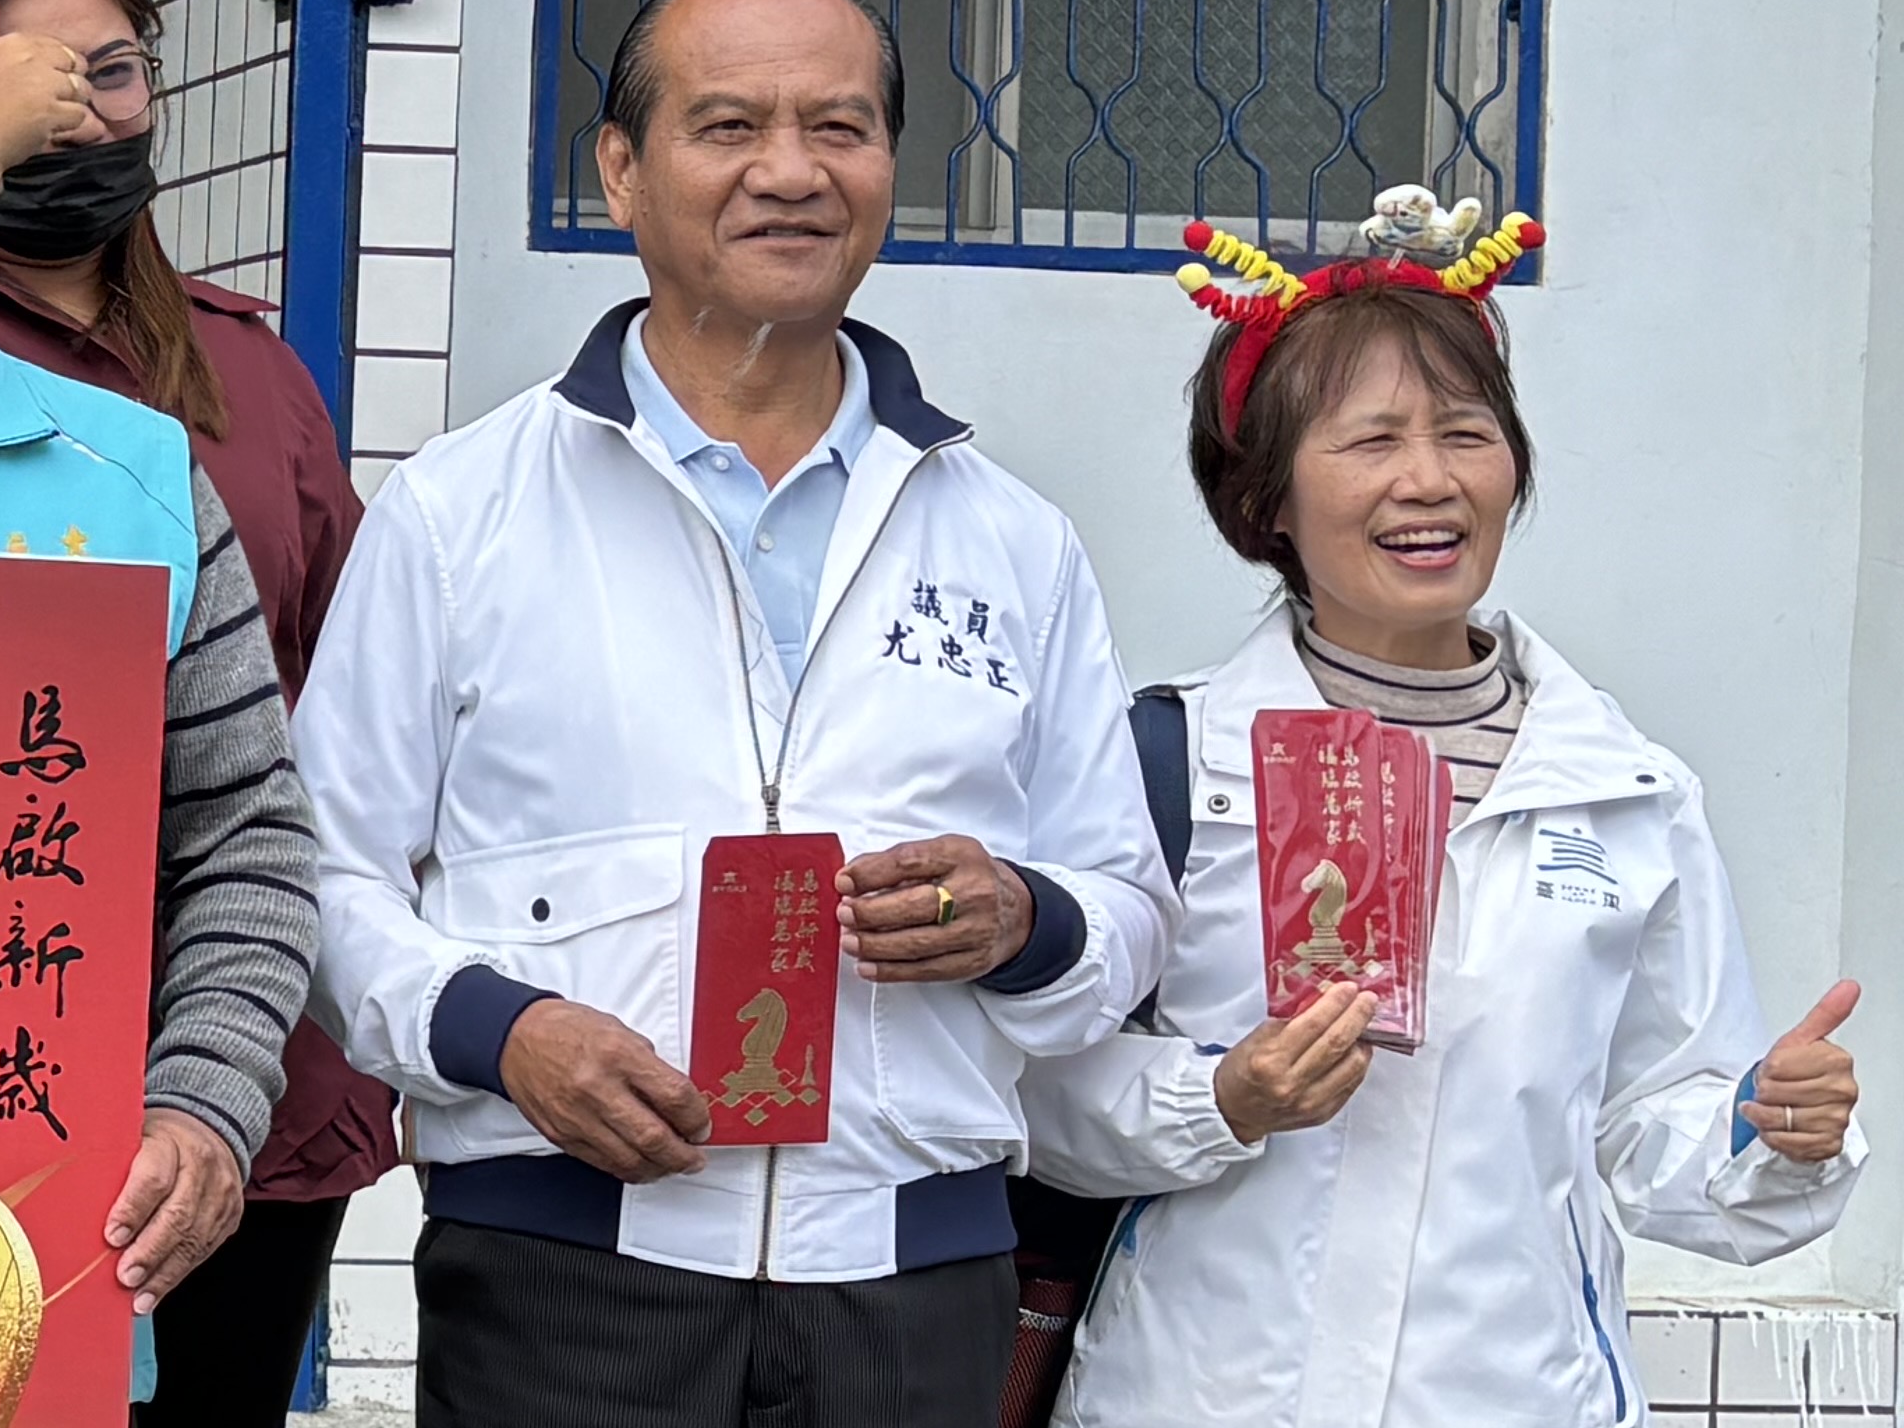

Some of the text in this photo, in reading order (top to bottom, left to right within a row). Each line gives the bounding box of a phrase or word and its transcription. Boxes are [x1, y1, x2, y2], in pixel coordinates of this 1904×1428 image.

[911, 578, 990, 645] 議員
[881, 619, 1020, 698] 尤忠正
